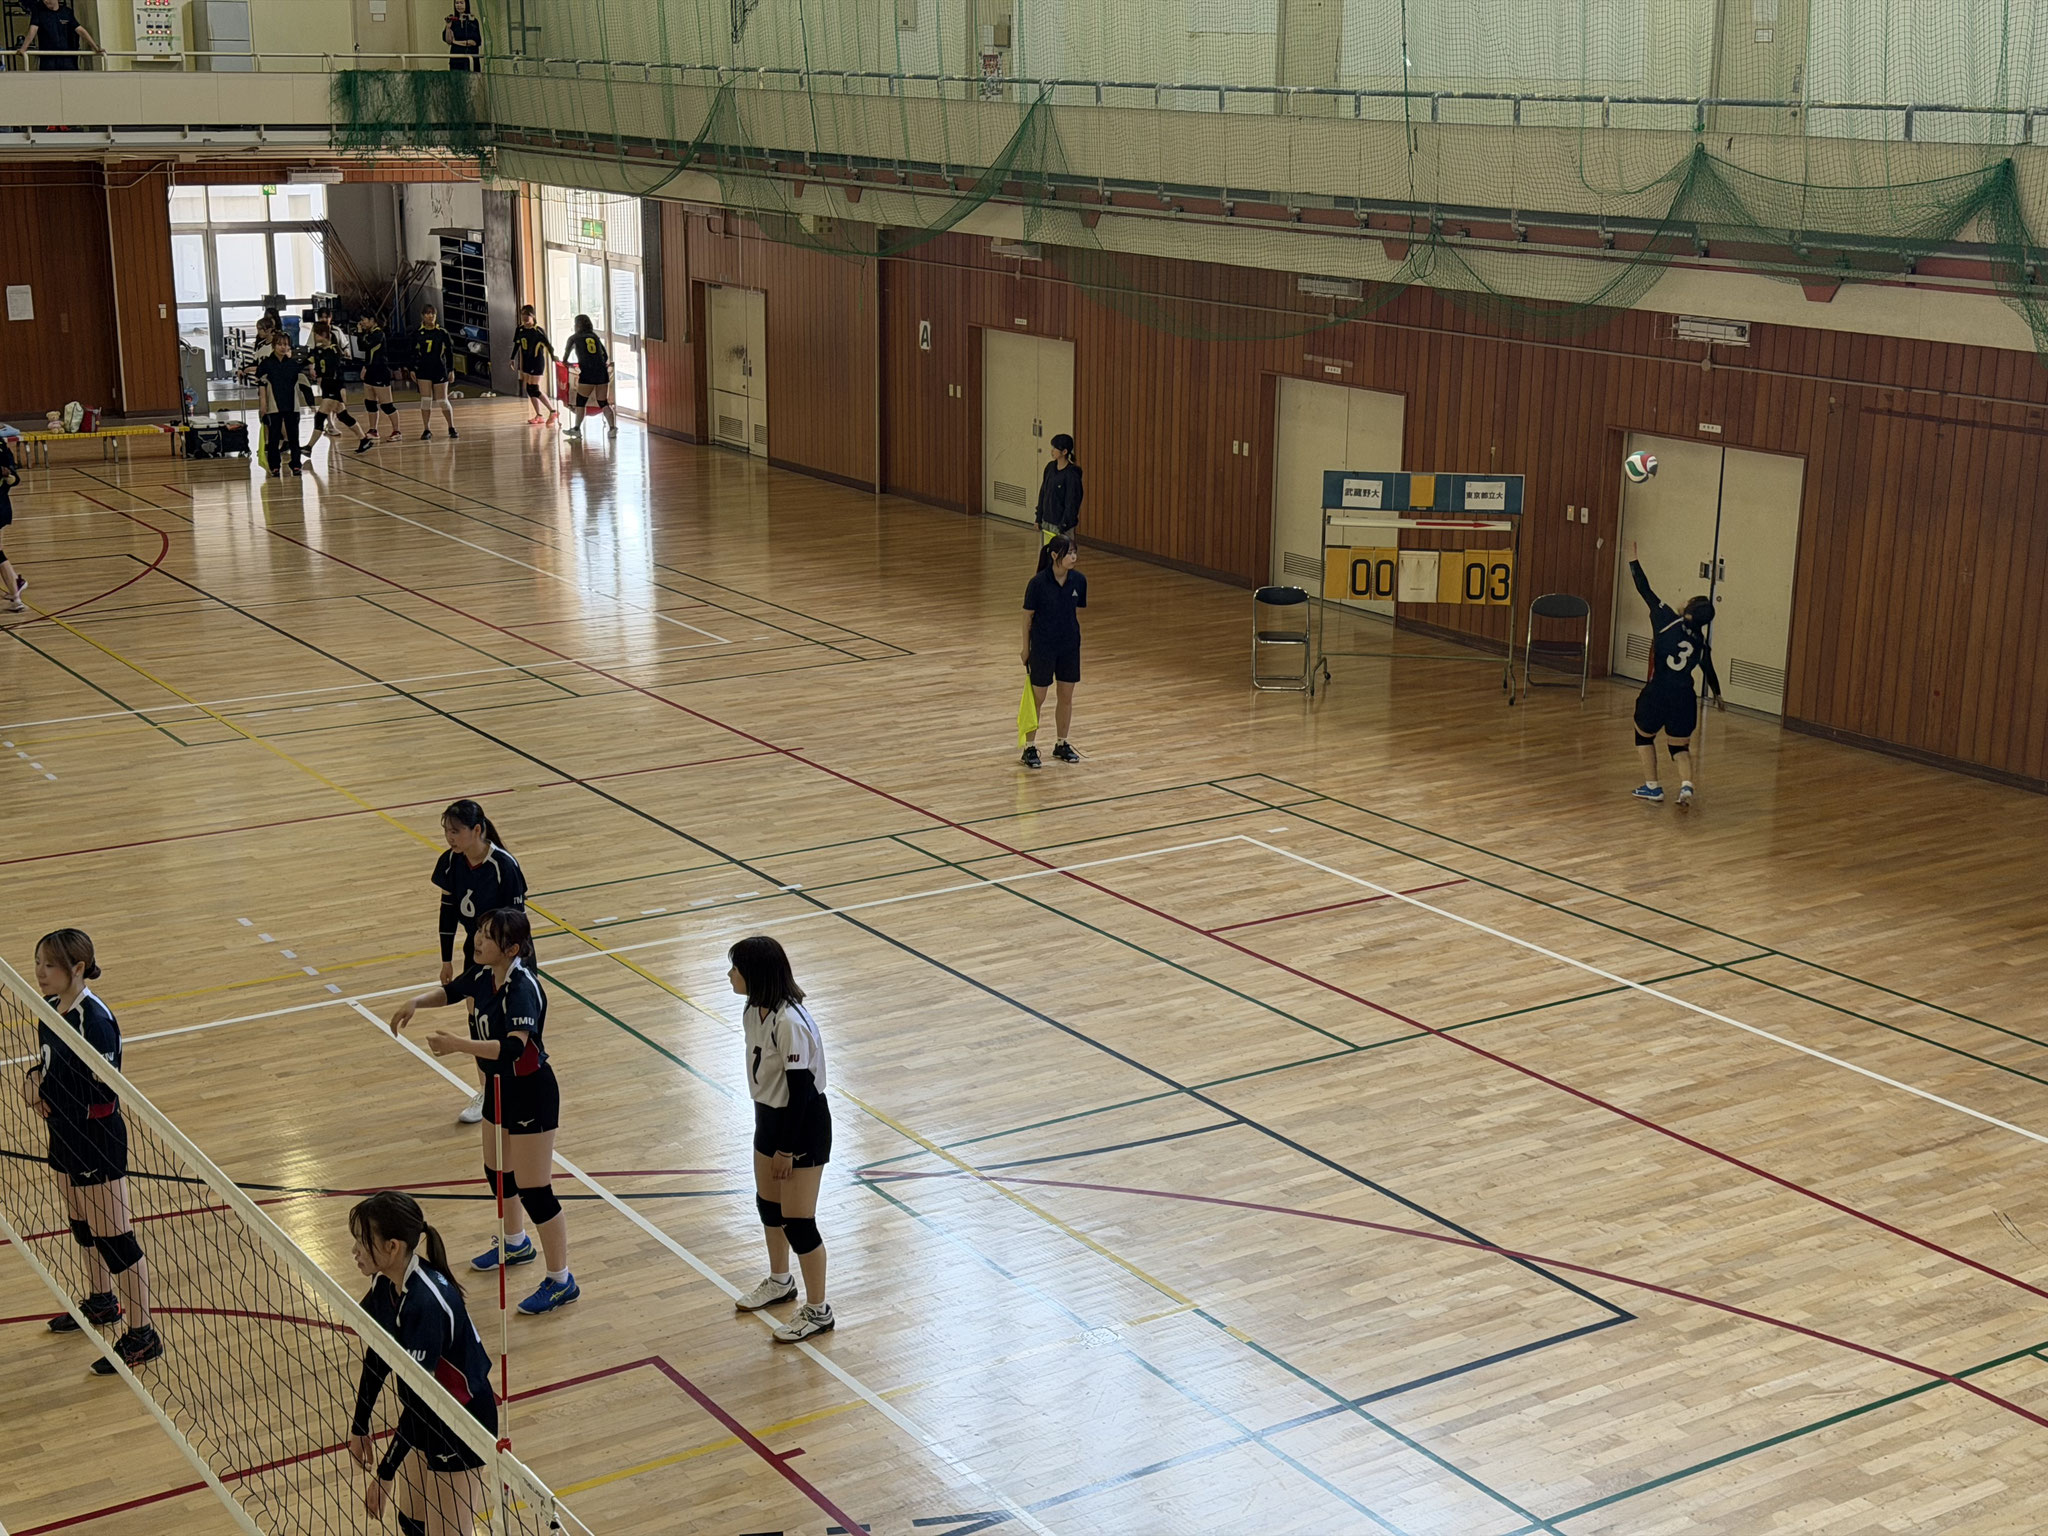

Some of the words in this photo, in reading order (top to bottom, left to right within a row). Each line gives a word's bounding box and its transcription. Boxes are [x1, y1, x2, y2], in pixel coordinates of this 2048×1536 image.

[425, 340, 433, 353] 7
[920, 325, 930, 347] A
[1344, 487, 1380, 498] 武蔵野大
[1466, 491, 1504, 500] 東京都立大
[1351, 559, 1395, 596] 00
[1466, 563, 1511, 600] 03
[1666, 640, 1694, 672] 3
[460, 888, 476, 918] 6
[511, 1016, 535, 1026] TMU
